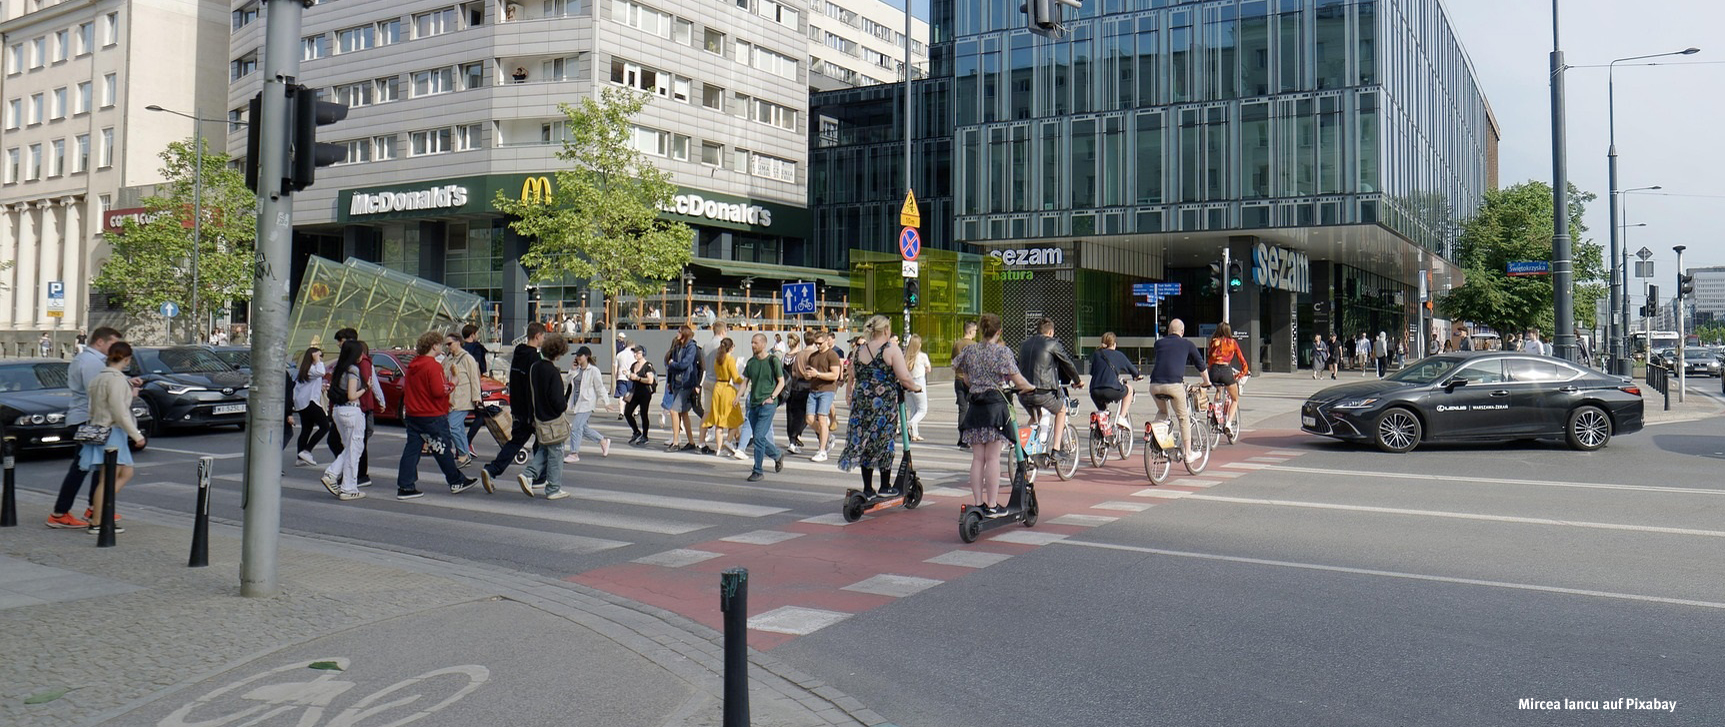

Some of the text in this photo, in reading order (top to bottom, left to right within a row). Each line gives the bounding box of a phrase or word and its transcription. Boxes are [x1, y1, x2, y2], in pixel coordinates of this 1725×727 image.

[350, 185, 467, 215] McDonald's
[110, 213, 139, 228] COA
[990, 248, 1062, 266] sezam
[992, 269, 1033, 281] natura
[1257, 242, 1309, 293] sezam
[51, 283, 62, 294] P
